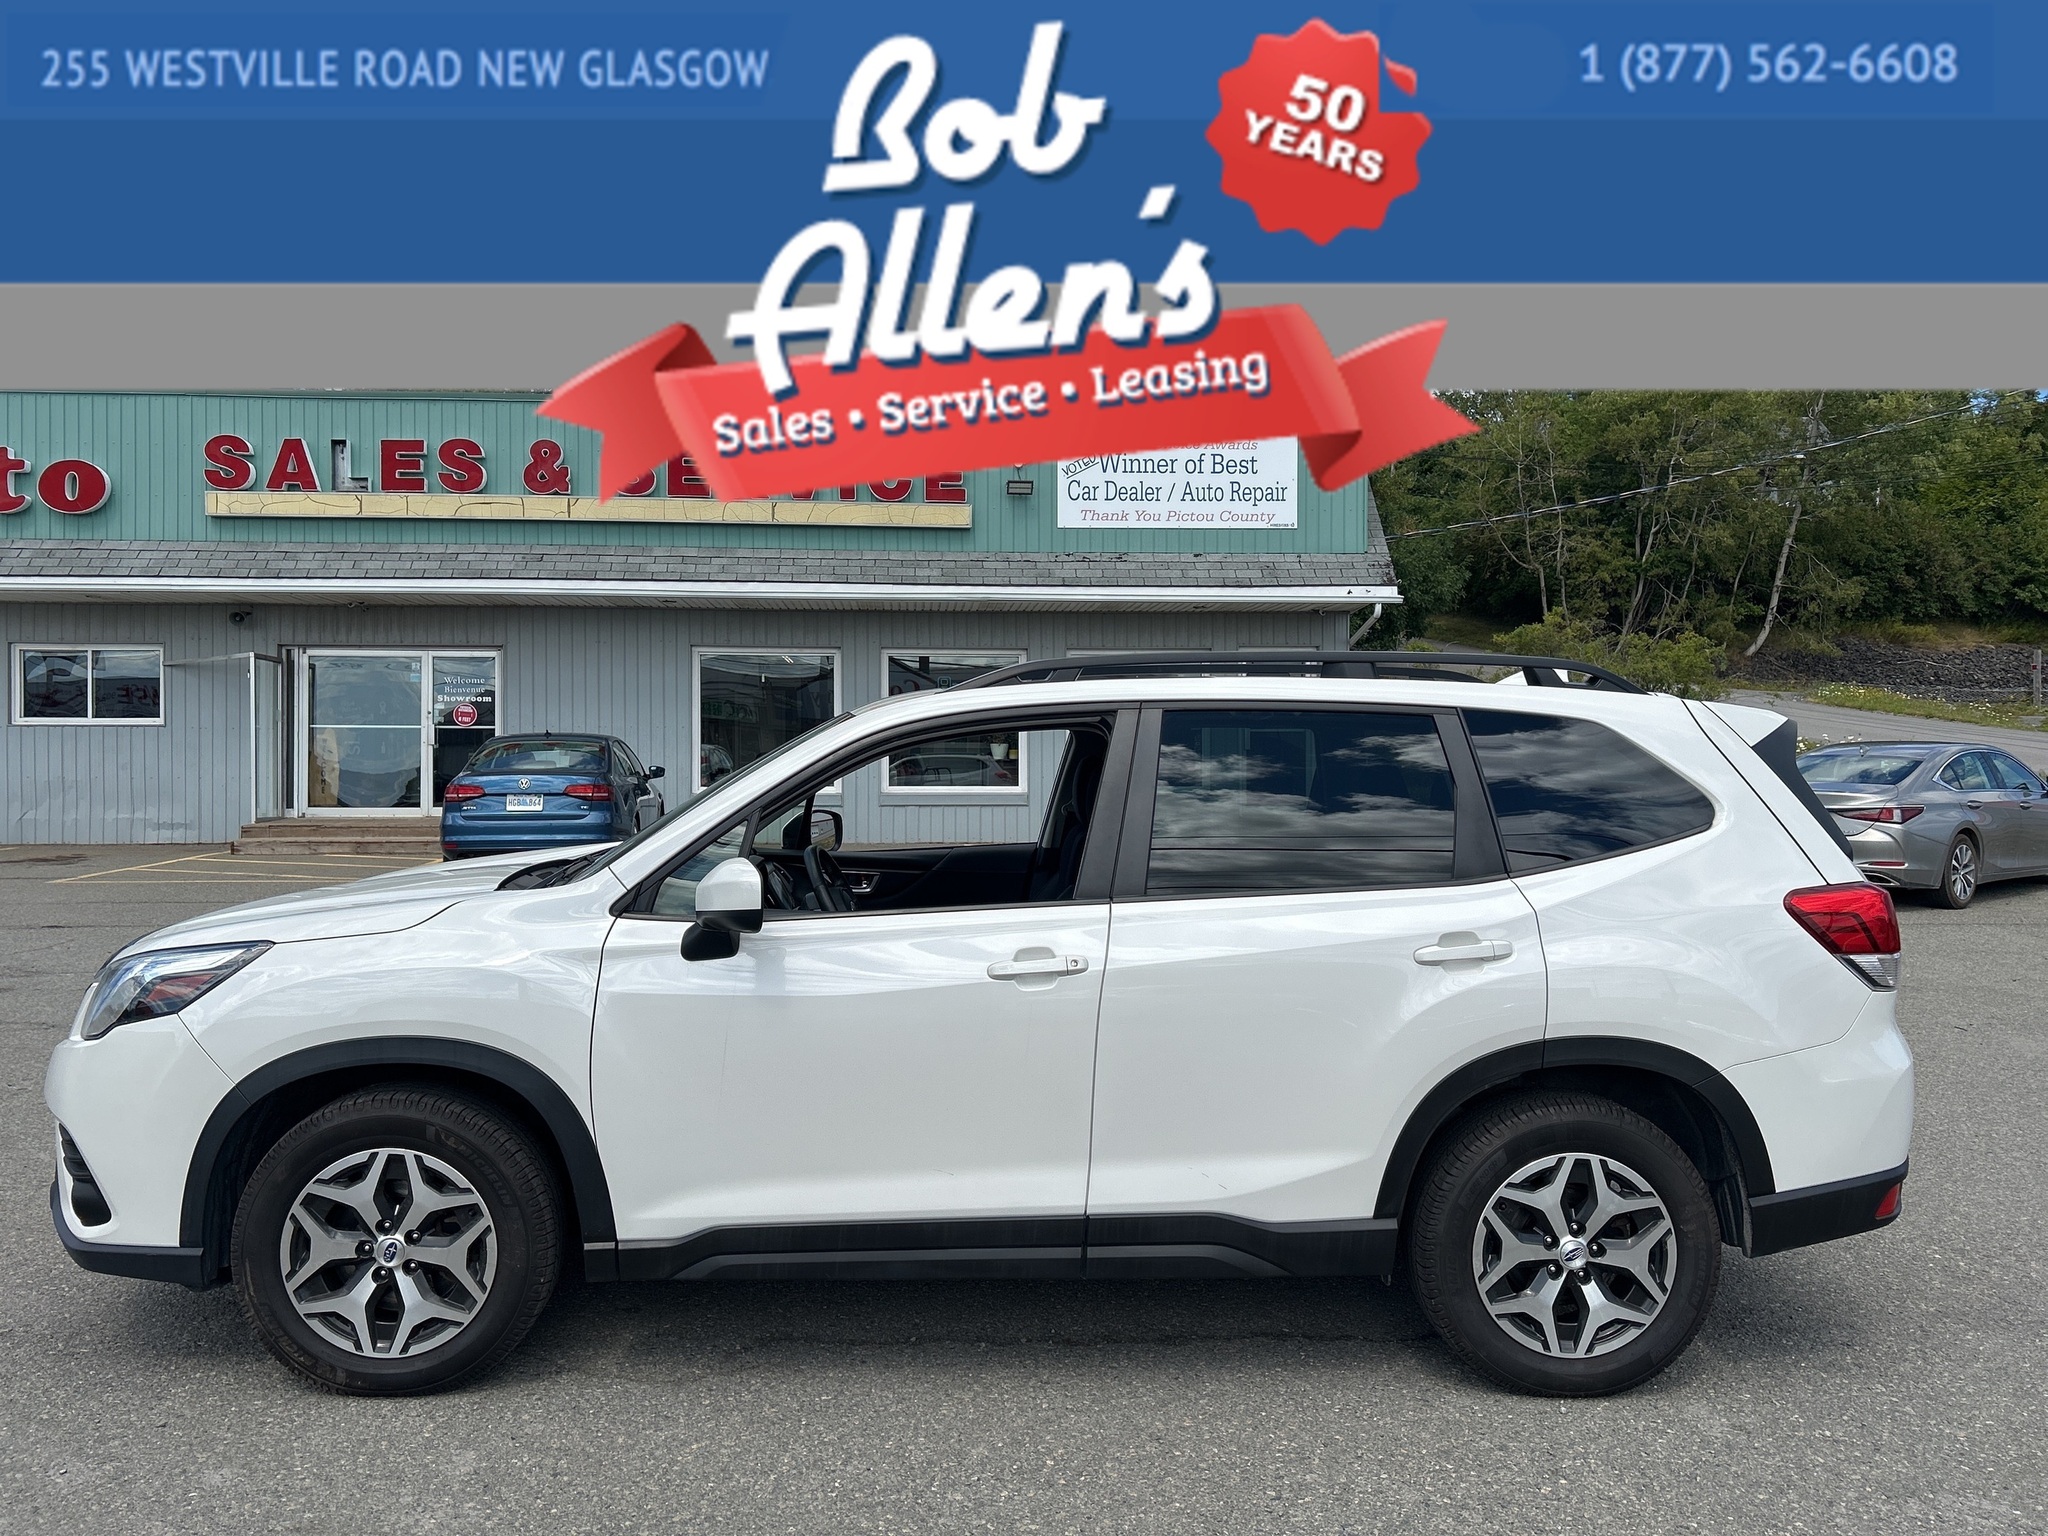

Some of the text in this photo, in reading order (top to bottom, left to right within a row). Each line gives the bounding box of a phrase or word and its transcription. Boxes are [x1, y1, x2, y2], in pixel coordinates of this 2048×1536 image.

[203, 433, 489, 494] SALES
[523, 438, 571, 495] &
[1061, 454, 1097, 477] VOTED
[1100, 453, 1258, 475] Winner of Best
[1067, 480, 1099, 502] Car
[1104, 480, 1162, 502] Dealer
[1180, 481, 1225, 503] Auto
[1229, 480, 1288, 507] Repair
[1080, 509, 1129, 522] Thank
[1135, 509, 1162, 522] You
[1166, 509, 1214, 522] Pictou
[1219, 509, 1276, 525] County
[443, 676, 486, 685] Welcome
[444, 685, 486, 693] Bienvenue
[437, 694, 492, 702] Showroom
